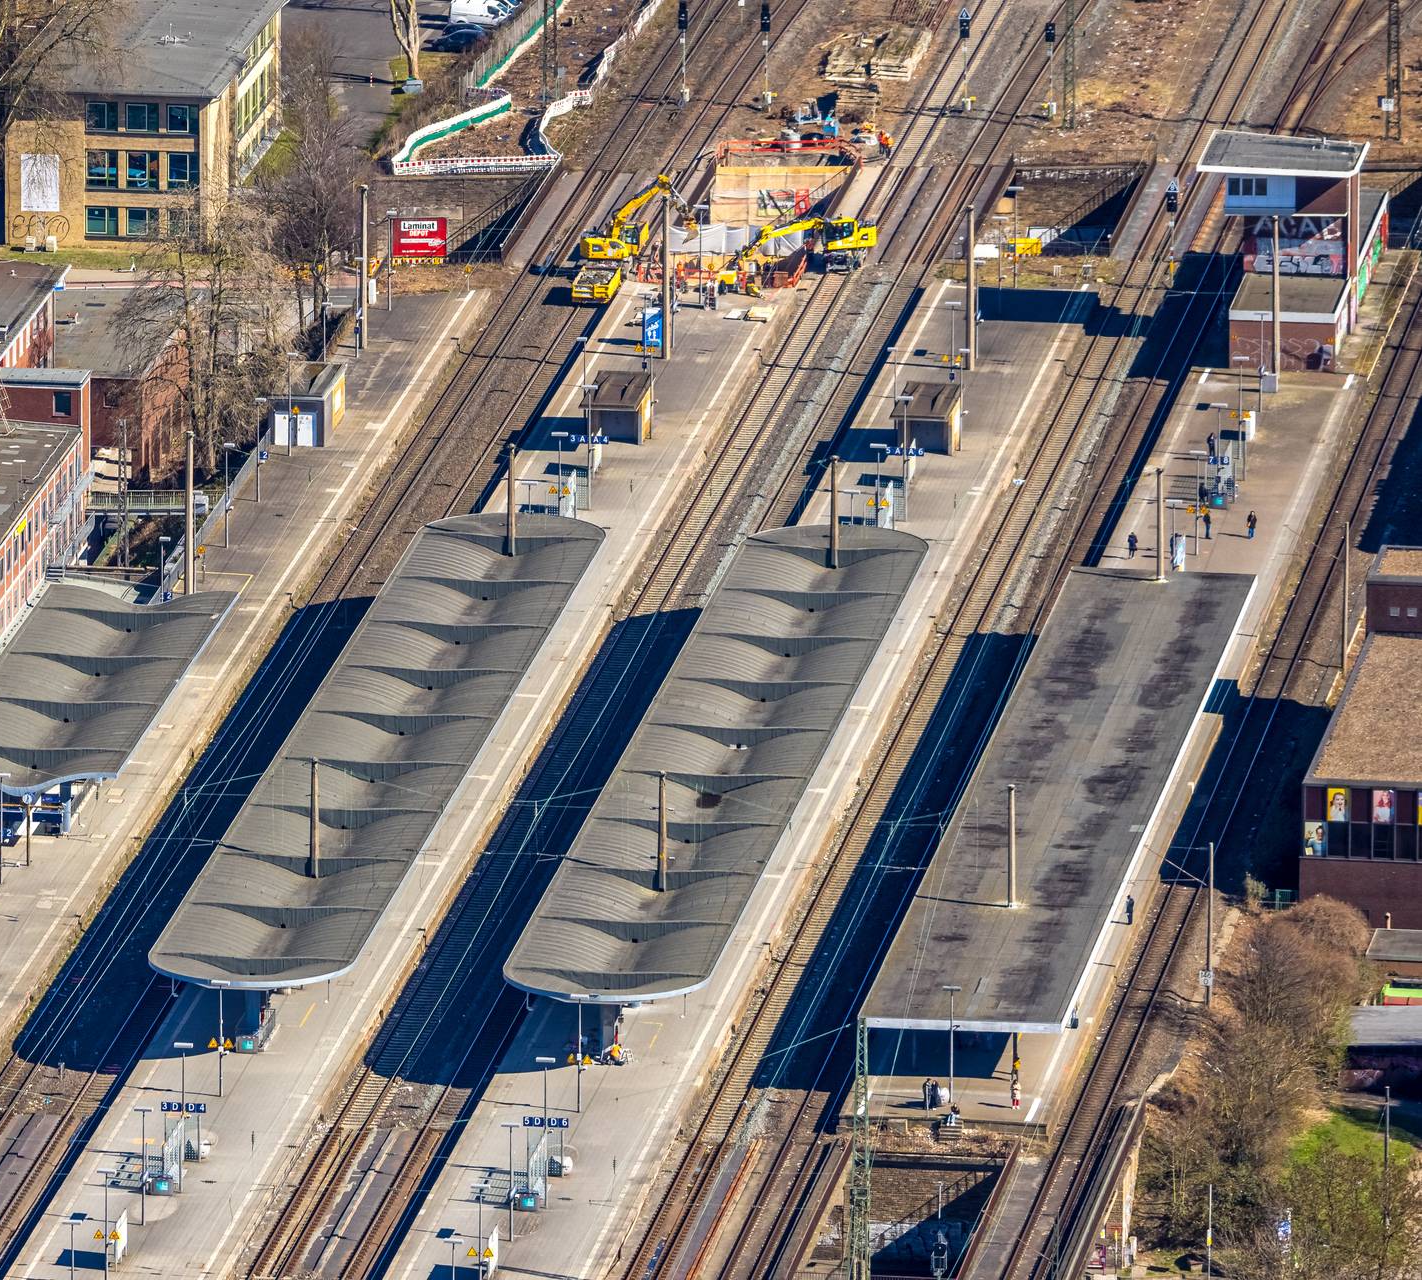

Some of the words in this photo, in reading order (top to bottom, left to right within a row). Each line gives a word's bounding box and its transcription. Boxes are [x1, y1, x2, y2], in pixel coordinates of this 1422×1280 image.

[403, 222, 435, 230] Laminat
[262, 451, 268, 459] 2
[886, 446, 891, 454] 5
[894, 447, 901, 455] A
[6, 828, 12, 837] 2
[162, 1102, 168, 1110] 3
[172, 1102, 179, 1111] D
[188, 1103, 195, 1111] D
[524, 1117, 530, 1125] 5
[534, 1117, 541, 1126] D
[550, 1118, 557, 1126] D
[562, 1118, 568, 1126] 6
